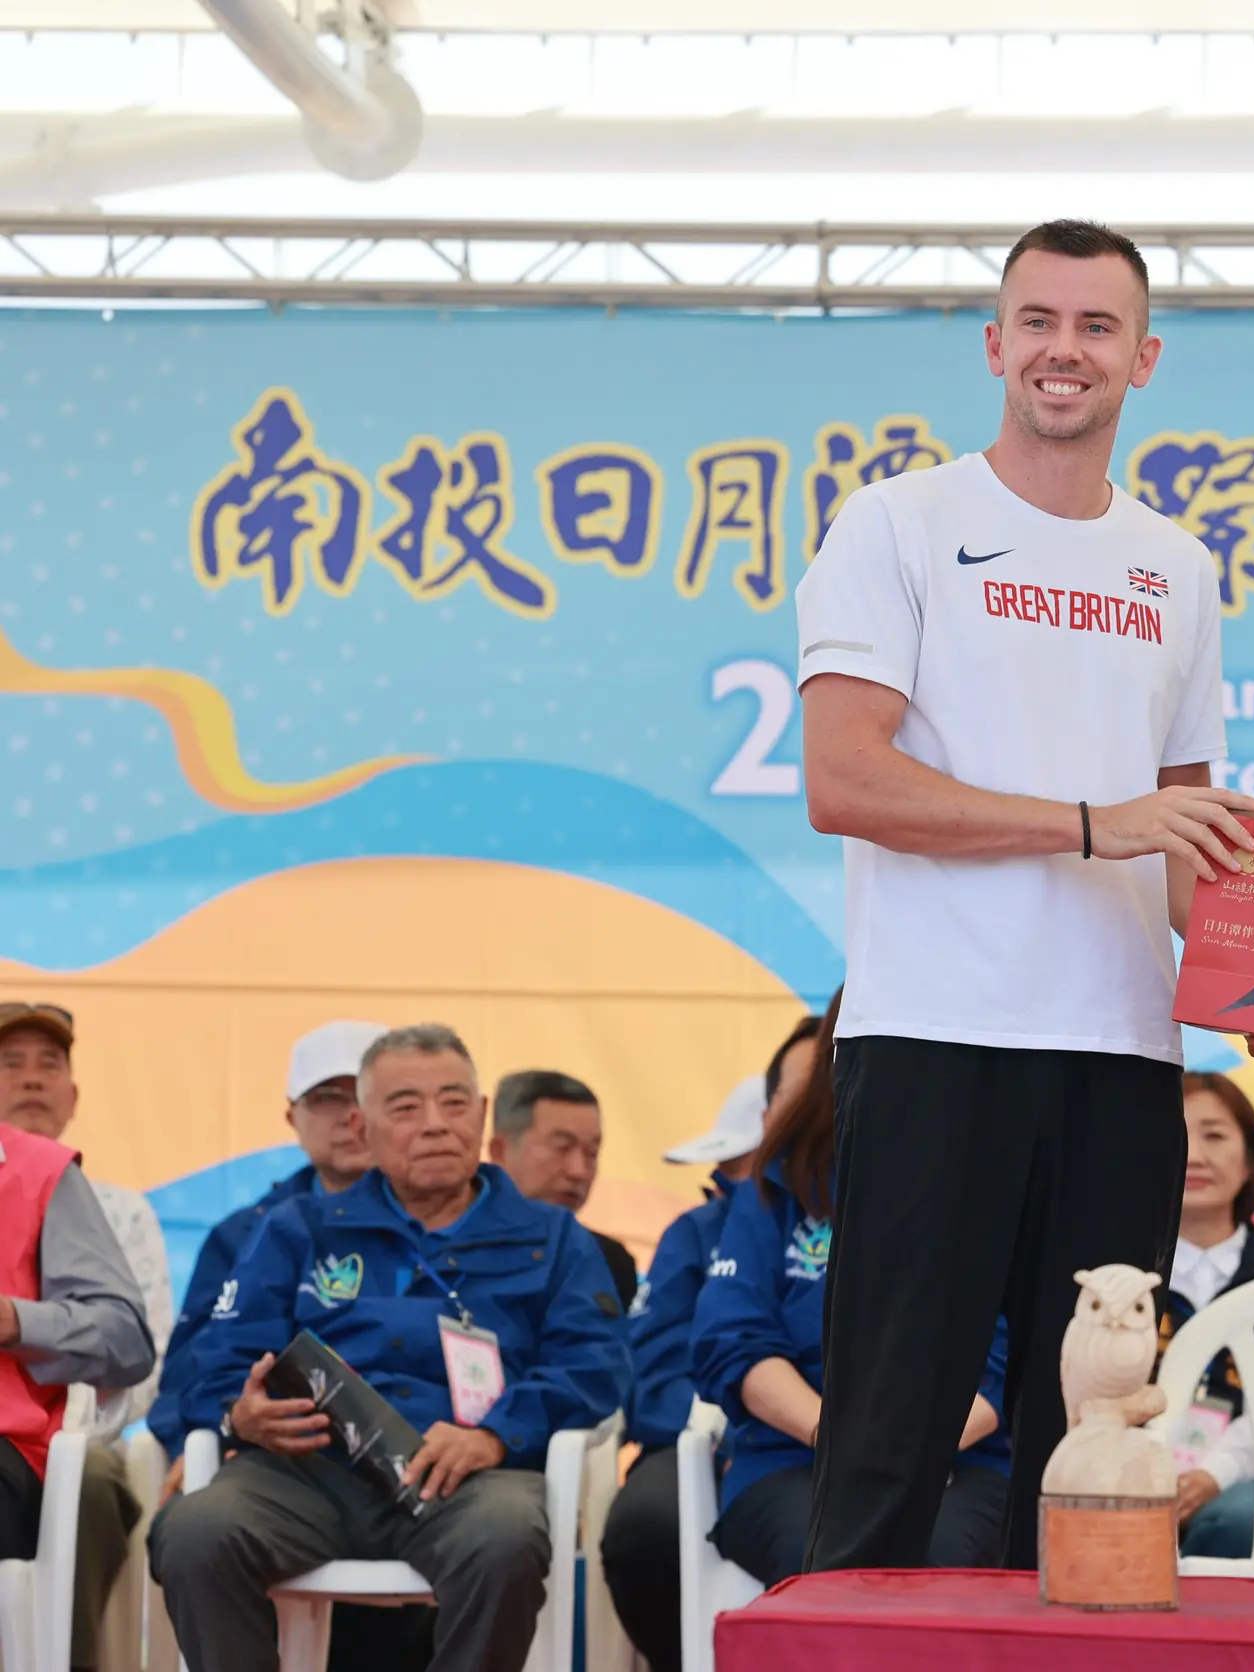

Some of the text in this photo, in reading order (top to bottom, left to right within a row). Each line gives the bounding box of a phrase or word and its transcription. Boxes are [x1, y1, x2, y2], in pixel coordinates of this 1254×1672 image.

[983, 580, 1163, 646] GREAT BRITAIN
[1200, 935, 1221, 945] Sun
[1221, 939, 1249, 950] Moon
